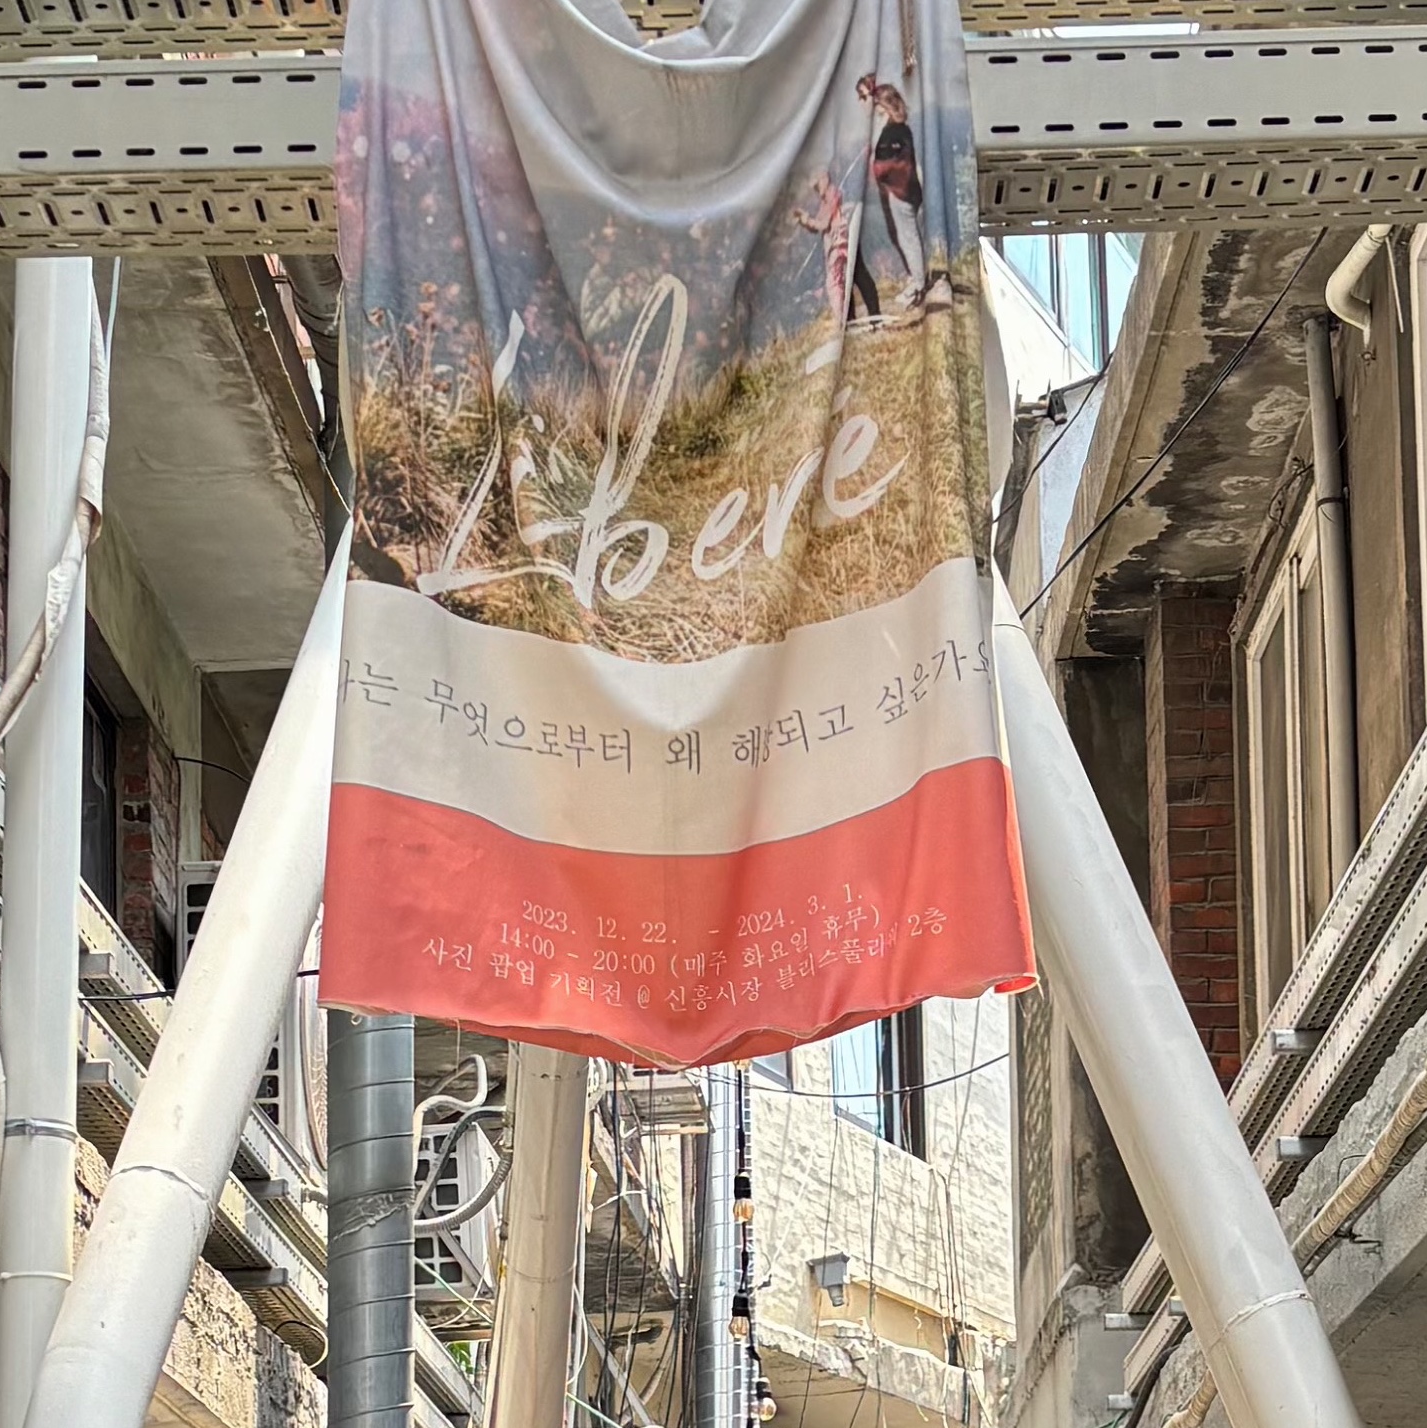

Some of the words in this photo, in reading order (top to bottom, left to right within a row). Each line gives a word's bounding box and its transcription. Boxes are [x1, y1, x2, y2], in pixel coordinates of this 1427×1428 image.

[424, 678, 633, 775] 무엇으로부터
[665, 729, 701, 775] 왜
[500, 922, 556, 960] 14:00
[592, 949, 656, 976] 20:00
[670, 951, 728, 979] (매주
[742, 927, 809, 969] 화요일
[822, 904, 881, 941] 휴무)
[522, 899, 577, 936] 2023.
[595, 916, 627, 941] 12.
[641, 922, 678, 944] 22.
[737, 908, 796, 938] 2024.
[807, 895, 827, 916] 3.
[843, 883, 864, 905] 1.
[421, 937, 474, 973] 사진
[489, 952, 536, 987] 팝업
[549, 972, 623, 1008] 기획전
[637, 985, 652, 1010] @
[665, 976, 763, 1013] 신흥시장
[907, 906, 948, 938] 2층
